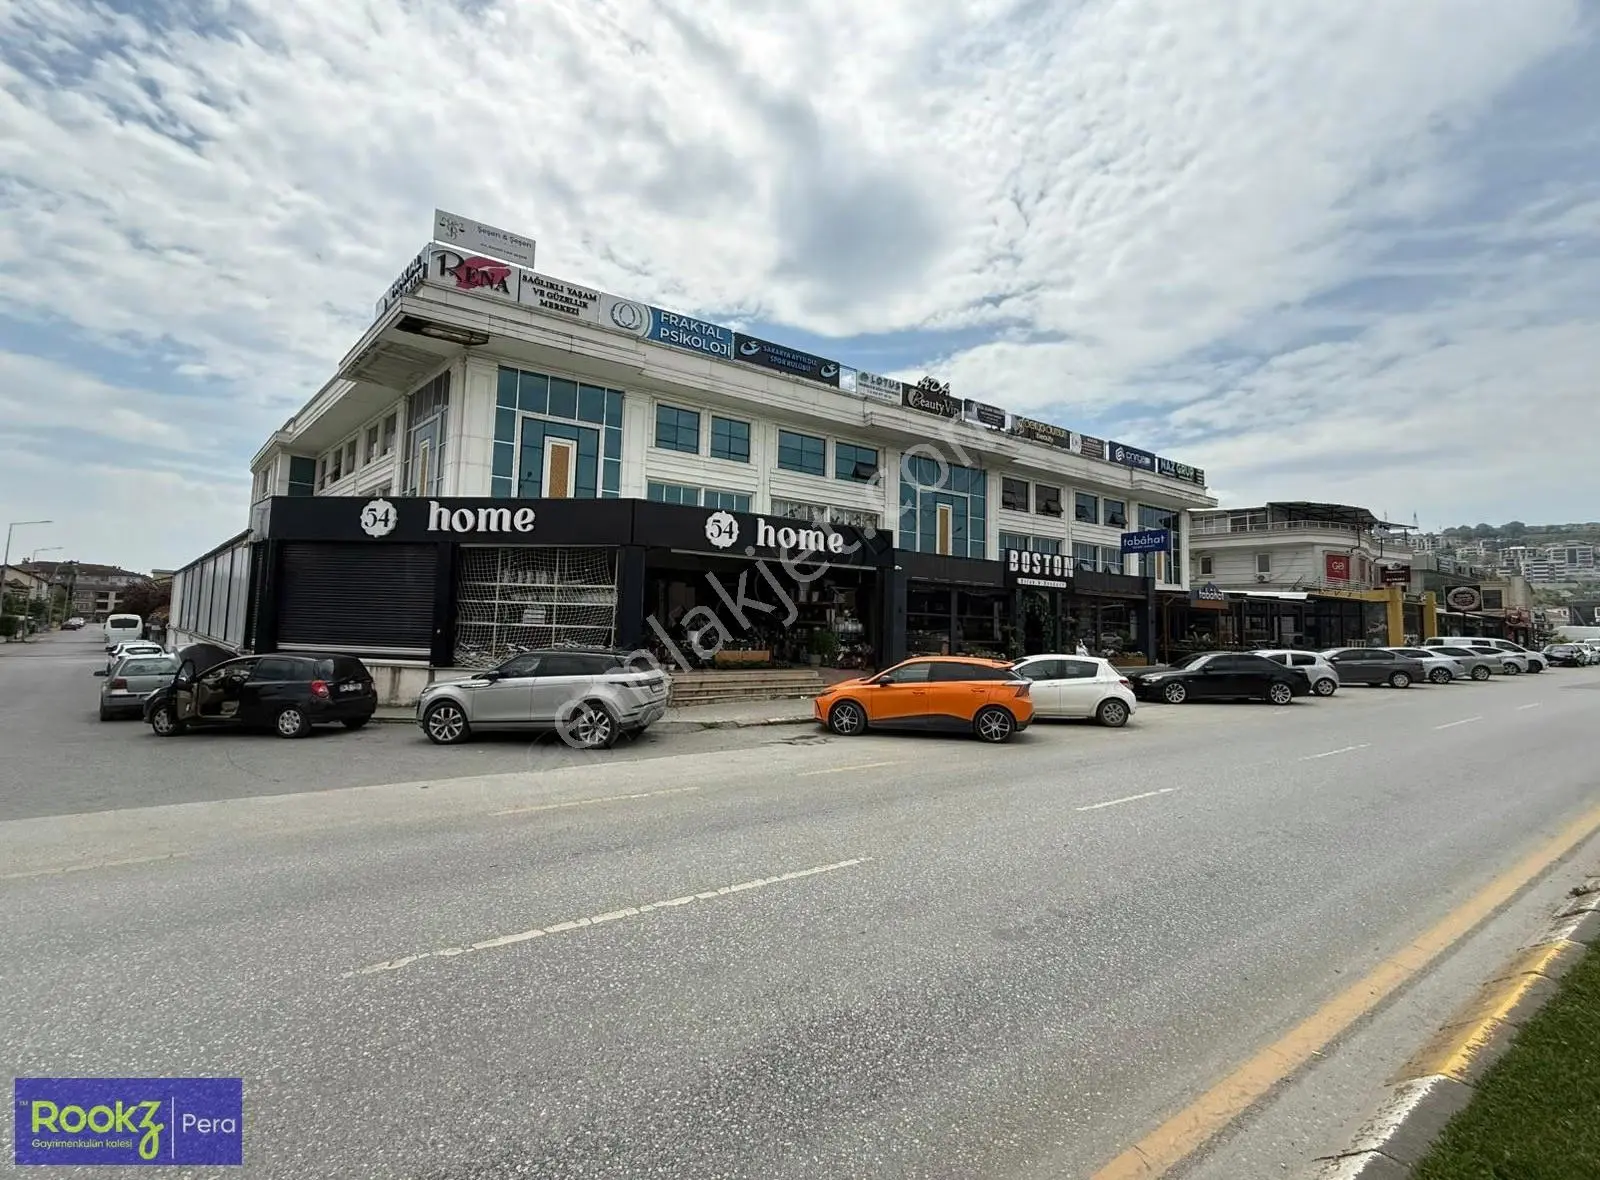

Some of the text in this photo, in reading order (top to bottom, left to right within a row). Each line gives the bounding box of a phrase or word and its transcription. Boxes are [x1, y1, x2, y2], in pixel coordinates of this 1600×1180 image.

[431, 250, 510, 294] RENA
[522, 275, 597, 301] SAĞLIKLI YAŞAM
[533, 287, 545, 297] VE
[540, 298, 579, 316] MERKEZİ
[661, 311, 723, 340] FRAKTAL
[660, 327, 731, 357] PSİKOLOJİ
[762, 345, 790, 359] SAKARYA
[870, 375, 901, 391] LOTUS
[918, 376, 950, 396] ADA
[364, 500, 536, 533] 54 home
[710, 518, 844, 554] 54 home
[1009, 549, 1074, 578] BOSTON
